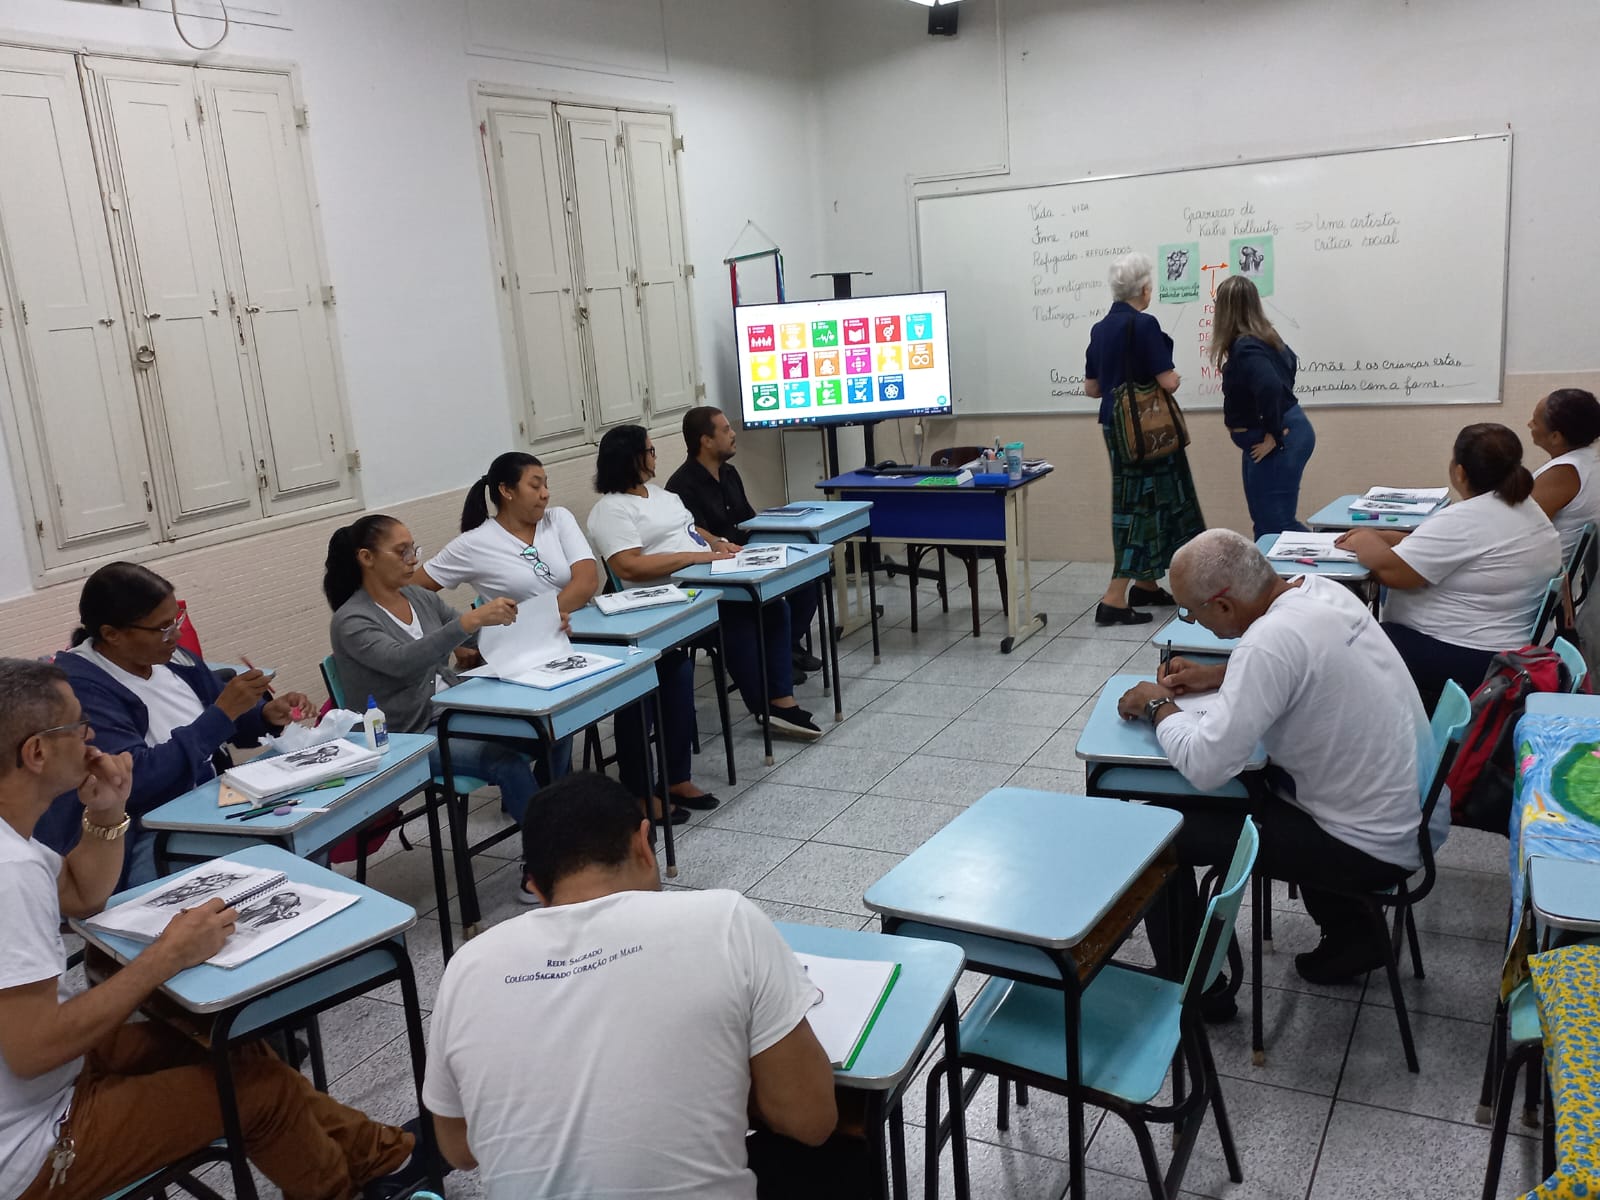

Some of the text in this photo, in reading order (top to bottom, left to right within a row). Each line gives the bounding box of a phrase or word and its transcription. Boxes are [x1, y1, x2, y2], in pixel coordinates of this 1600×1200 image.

[1072, 203, 1089, 214] VIDA
[1240, 200, 1256, 216] de
[1350, 210, 1400, 229] artista
[1070, 229, 1089, 240] FOME
[1085, 246, 1133, 258] REFUGIADOS
[535, 971, 571, 980] SAGRADO
[620, 944, 643, 957] MARIA
